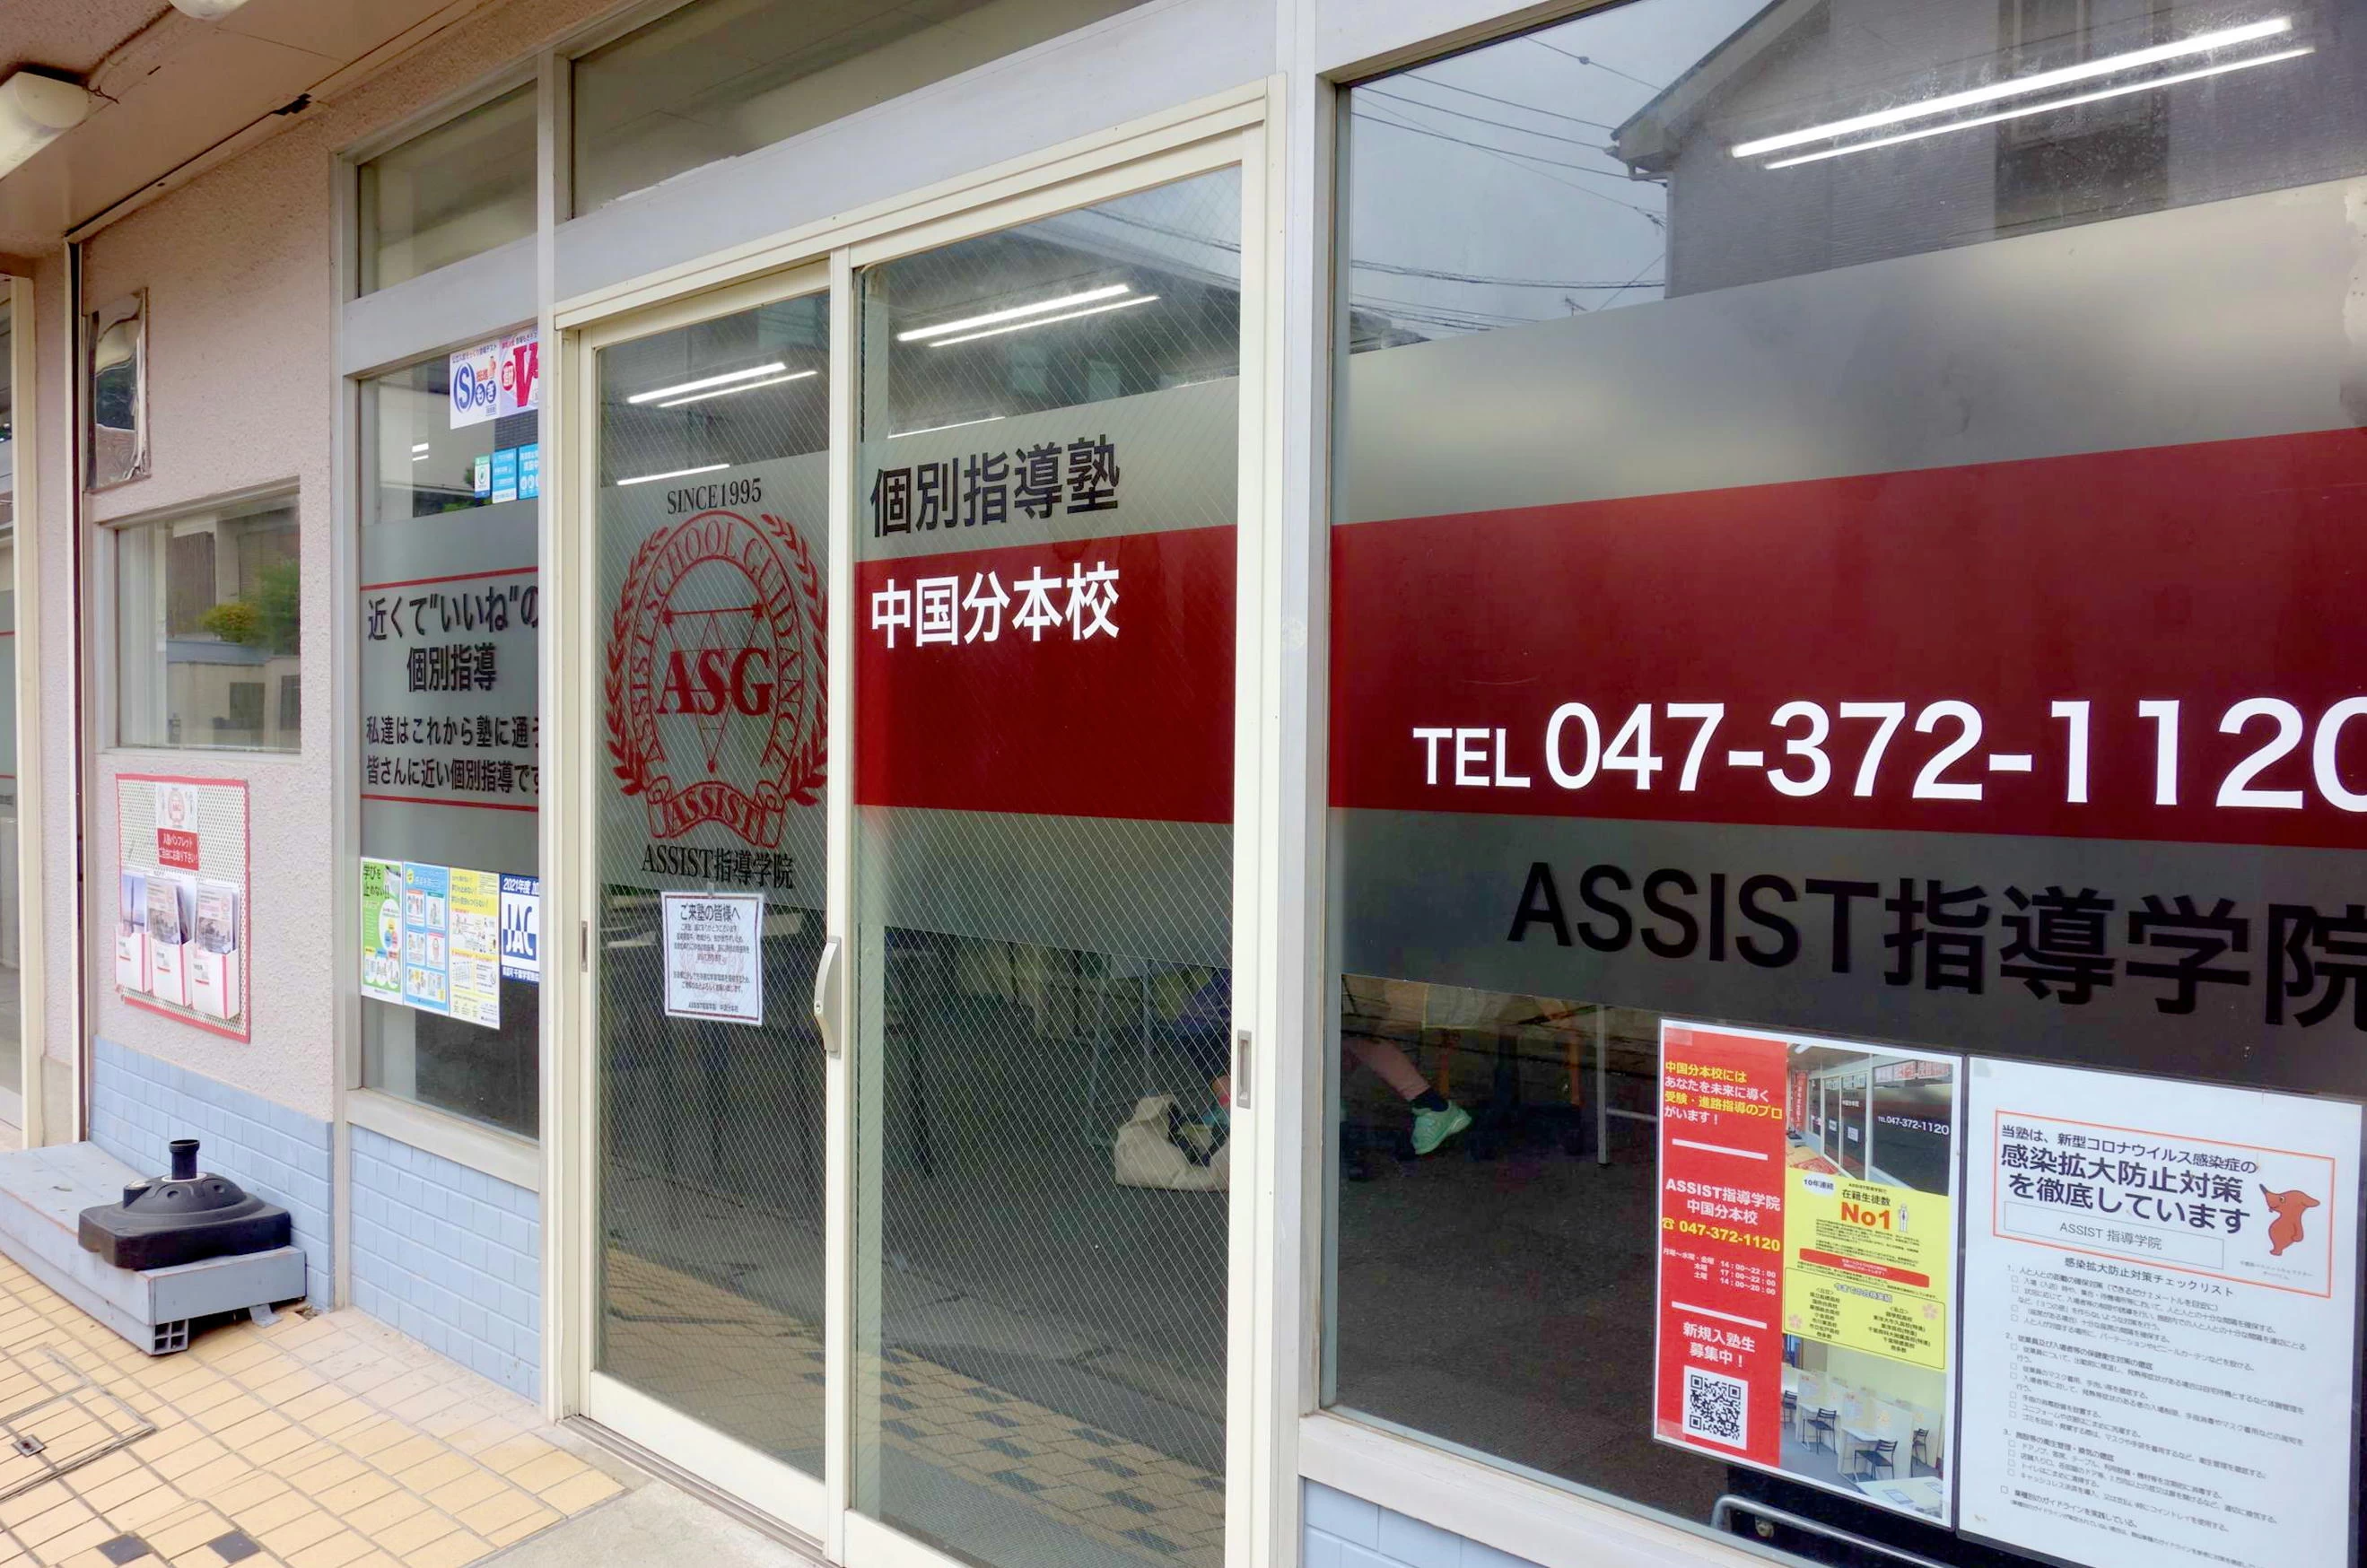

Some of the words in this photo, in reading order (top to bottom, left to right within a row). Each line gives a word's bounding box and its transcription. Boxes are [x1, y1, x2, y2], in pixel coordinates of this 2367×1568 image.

[869, 434, 1120, 538] 個別指導塾
[871, 561, 1120, 649] 中国分本校
[645, 519, 738, 621] SCHOOL
[743, 538, 802, 769] GUIDANCE
[406, 642, 496, 693] 個別指導
[657, 647, 773, 716] ASG
[1412, 727, 1531, 788] TEL
[1545, 696, 2367, 813] 047-372-1120
[670, 786, 764, 837] ASSIST
[642, 844, 794, 890] ASSIST指導学院
[505, 903, 534, 956] JAC
[681, 903, 740, 921] ご来塾の皆様へ
[1507, 861, 2367, 1032] ASSIST指導学院
[1664, 1076, 1769, 1102] あなたを未来に導く
[1665, 1061, 1747, 1083] 中国分本校には
[1664, 1091, 1783, 1119] 受験・進路指導のプロ
[1664, 1106, 1718, 1125] がいます！
[1886, 1116, 1949, 1135] 047-372-1120
[2002, 1124, 2258, 1174] 当塾は、新型コロナウイルス感染症の
[1665, 1178, 1780, 1211] ASSIST指導学院
[2001, 1144, 2244, 1205] 感染拡大防止対策
[1687, 1198, 1758, 1225] 中国分本校
[1841, 1201, 1890, 1230] No1
[1842, 1189, 1891, 1206] 在籍生徒数
[2008, 1172, 2251, 1233] を徹底しています
[1679, 1220, 1780, 1251] 047-372-1120
[2065, 1257, 2234, 1297] 感染拡大防止対策チェックリスト
[1682, 1321, 1756, 1354] 新規入塾生
[1690, 1342, 1743, 1367] 募集中！
